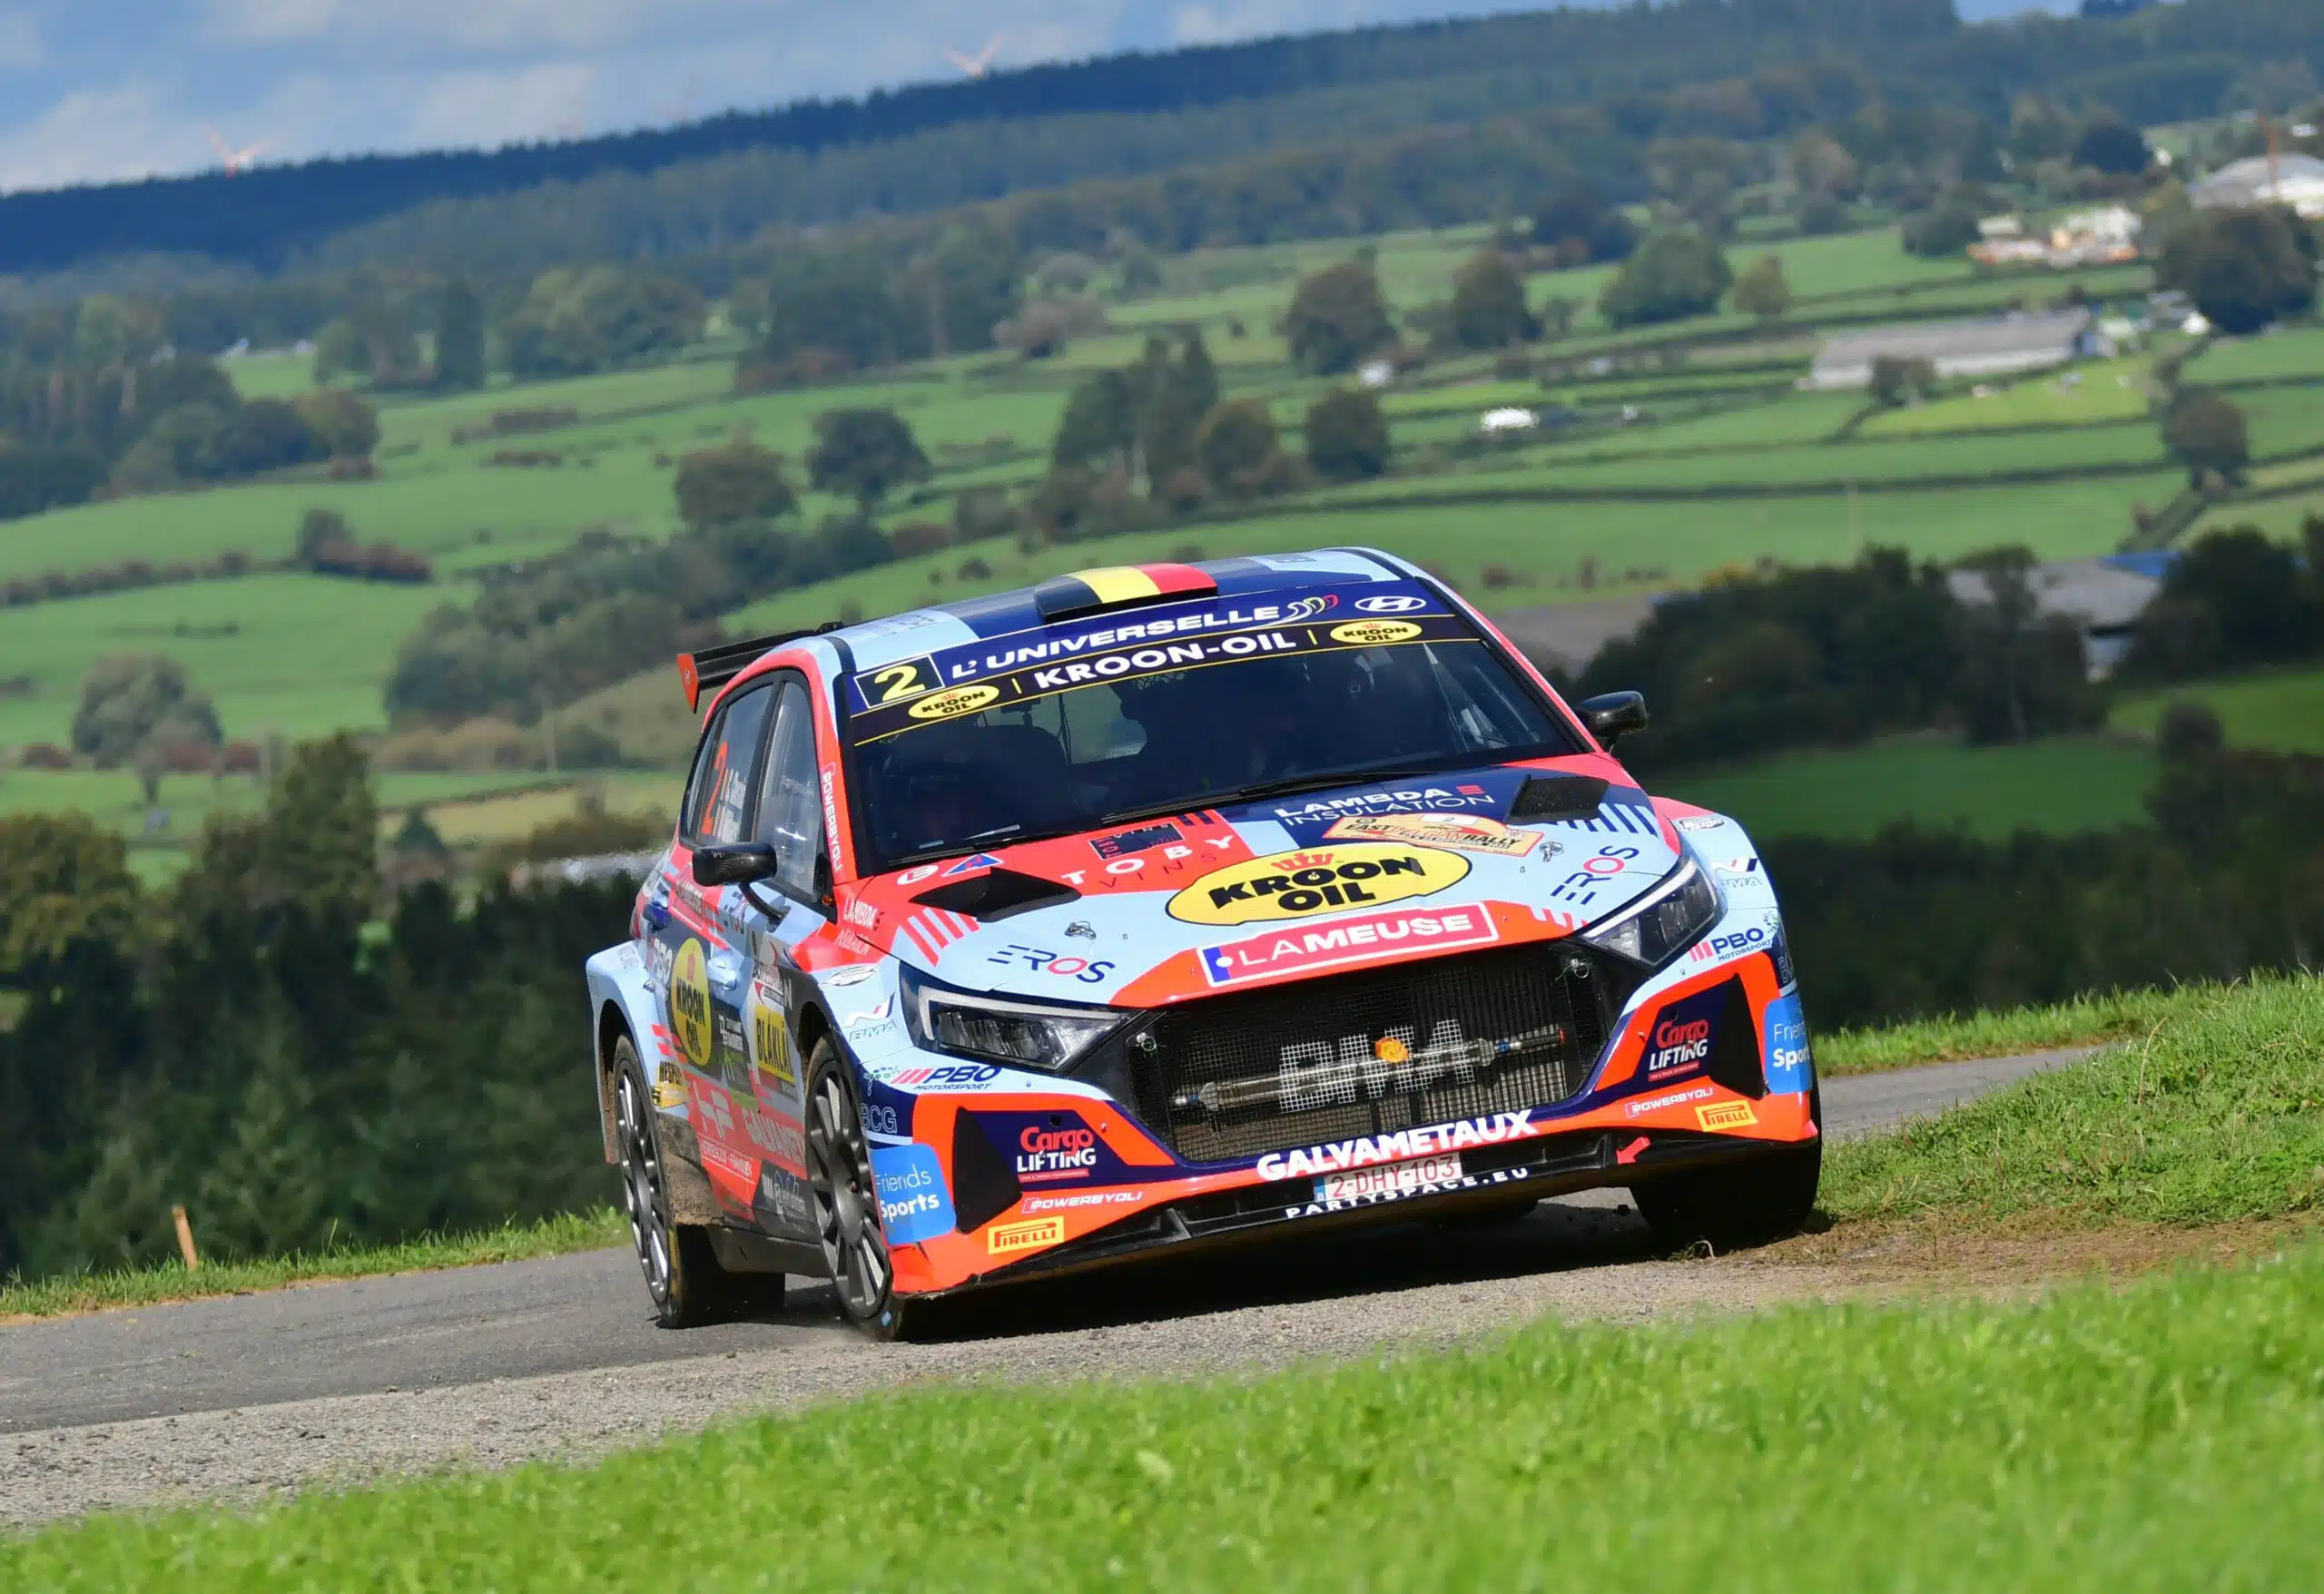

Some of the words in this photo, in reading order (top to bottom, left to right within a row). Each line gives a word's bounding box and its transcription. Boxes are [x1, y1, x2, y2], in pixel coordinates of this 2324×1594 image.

[987, 605, 1279, 669] UNIVERSELLE
[1344, 626, 1408, 637] KROON
[1364, 634, 1393, 642] OIL
[1033, 633, 1296, 689] KROON-OIL
[874, 665, 926, 702] 2
[921, 691, 986, 713] KROON
[941, 703, 970, 714] OIL
[1275, 788, 1453, 818] LAMBDA
[1284, 795, 1496, 827] INSULATION
[1061, 835, 1235, 885] TOBY
[1098, 853, 1218, 889] VINS
[1549, 845, 1640, 905] EROS
[1208, 857, 1426, 909] KROON
[1278, 881, 1377, 911] OIL
[1711, 928, 1764, 954] PBO
[1718, 940, 1772, 962] MOTORSPORT
[987, 944, 1117, 983] EROS
[676, 977, 706, 1028] KROON
[1657, 1019, 1709, 1049] Cargo
[1649, 1038, 1709, 1071] LIFTING
[913, 1083, 992, 1091] MOTORSPORT
[923, 1066, 1003, 1084] PBO
[1702, 1105, 1749, 1126] PIRELLI
[1019, 1127, 1094, 1156] Cargo
[1256, 1109, 1539, 1181] GALVAMETAUX
[1017, 1148, 1097, 1172] LIFTING
[995, 1223, 1057, 1248] PIRELLI
